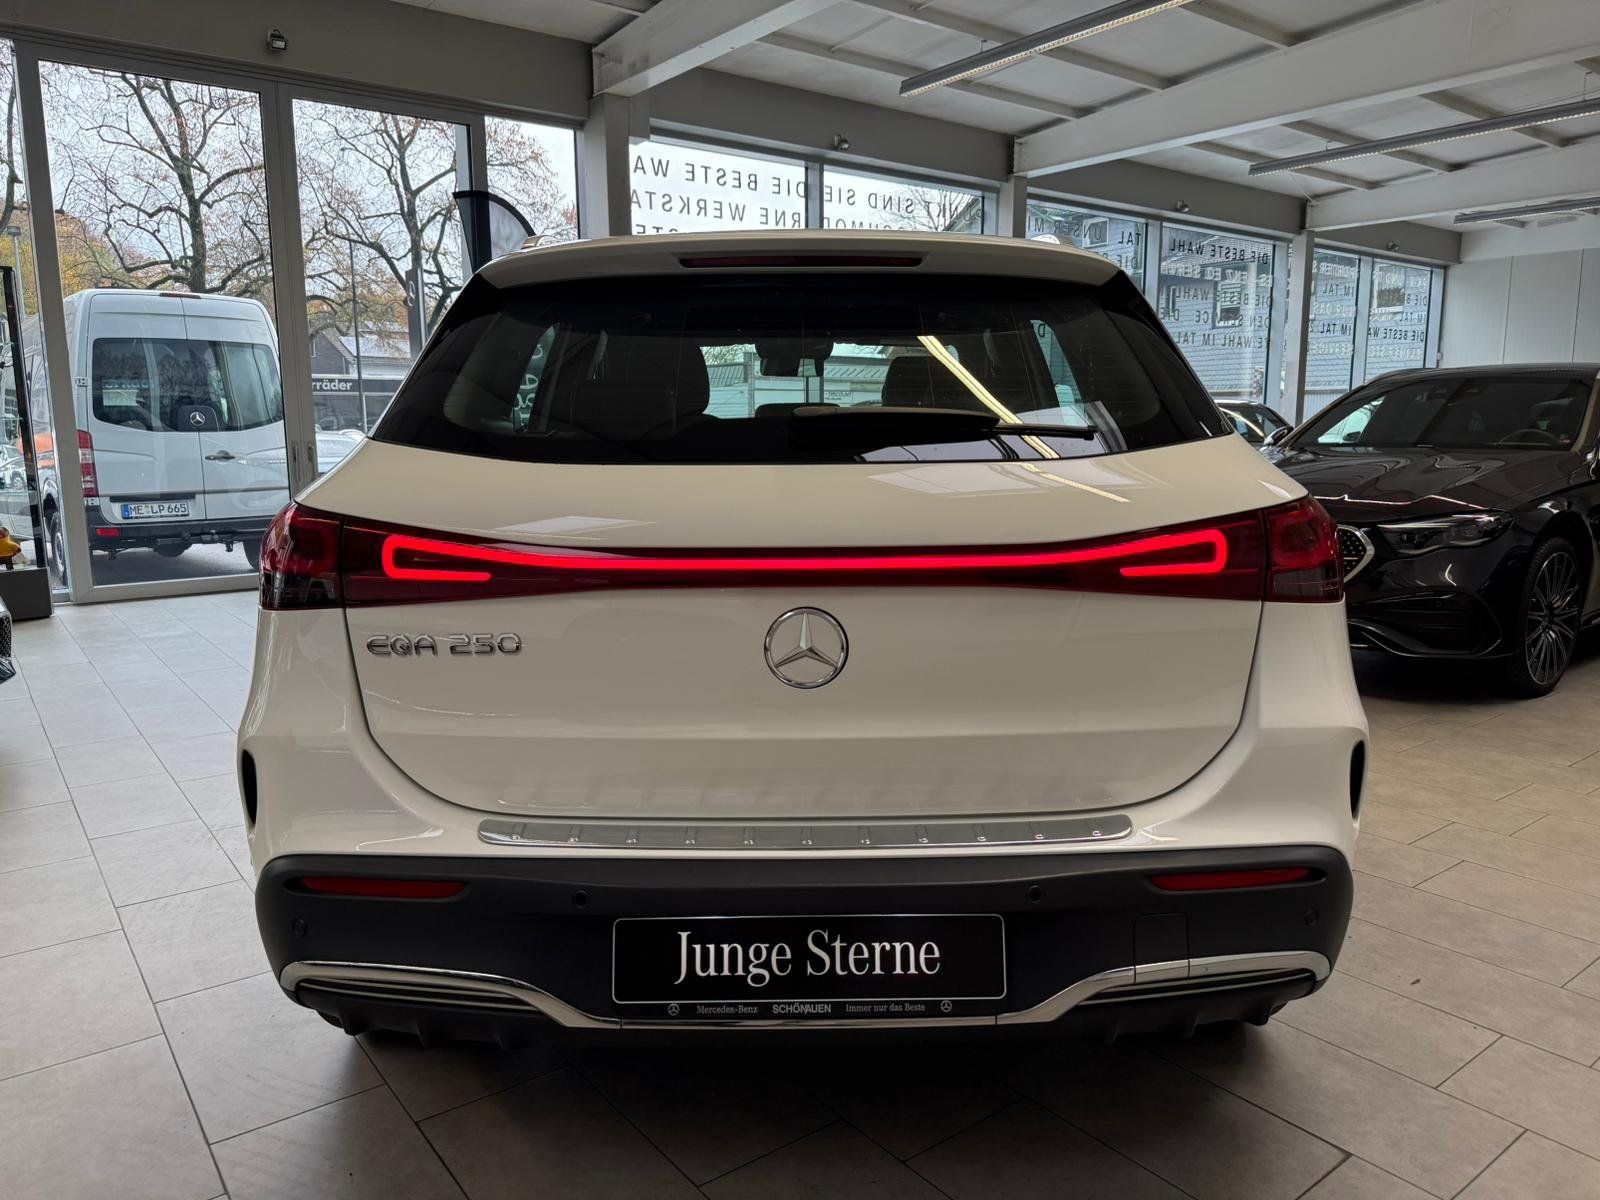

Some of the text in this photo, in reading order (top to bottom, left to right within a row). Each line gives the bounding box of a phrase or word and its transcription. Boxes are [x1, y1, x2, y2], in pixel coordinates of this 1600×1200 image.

[129, 503, 187, 515] ME LP 665
[366, 633, 522, 656] EQA 250
[674, 929, 941, 987] Junge Sterne
[696, 1004, 758, 1015] Mercedes-Benz
[846, 1003, 872, 1013] Immer
[873, 1004, 888, 1013] nur
[889, 1003, 904, 1013] das
[905, 1003, 926, 1013] Beste
